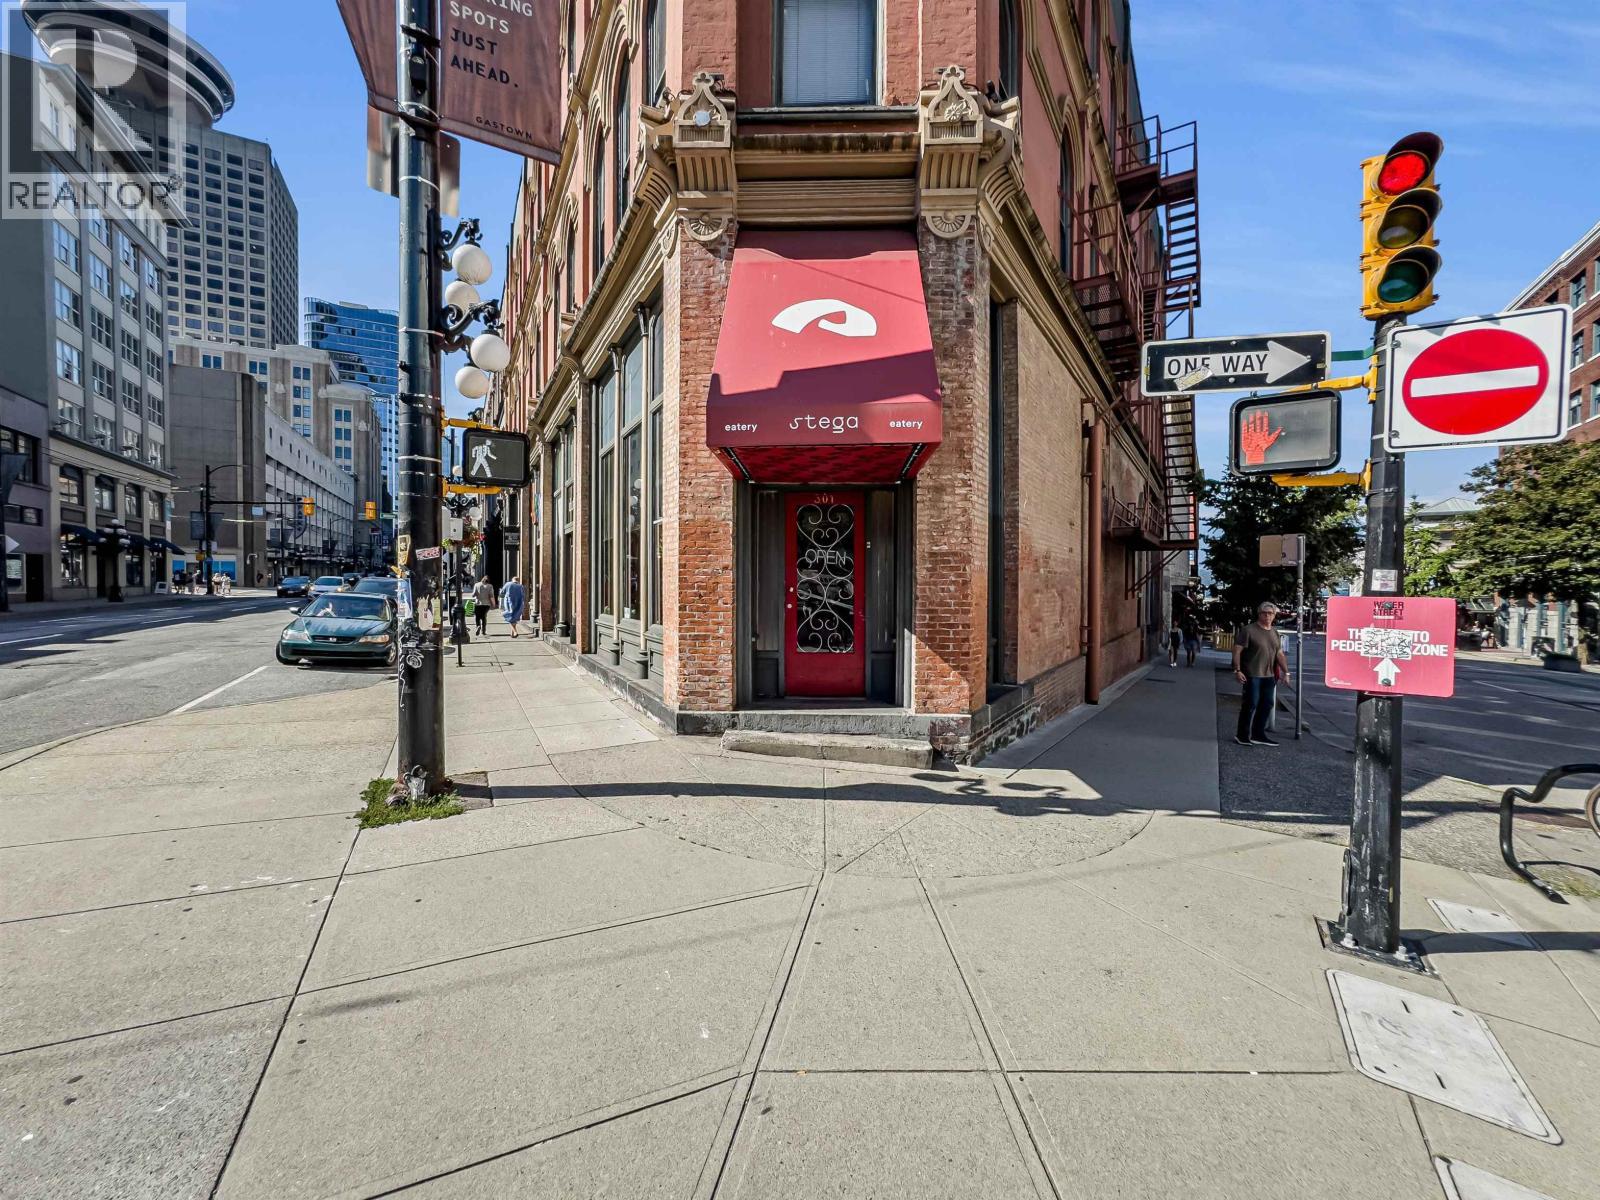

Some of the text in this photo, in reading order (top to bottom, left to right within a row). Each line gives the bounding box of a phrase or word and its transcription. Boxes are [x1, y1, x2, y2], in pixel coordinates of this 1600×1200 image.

[450, 1, 510, 34] SPOTS
[450, 28, 498, 56] JUST
[450, 55, 519, 88] AHEAD.
[475, 116, 533, 140] GASTOWN
[1222, 353, 1268, 373] WAY
[724, 414, 923, 434] eatery stega eatery
[805, 548, 847, 566] OPEN
[1412, 631, 1430, 643] TO
[1412, 643, 1449, 657] ZONE
